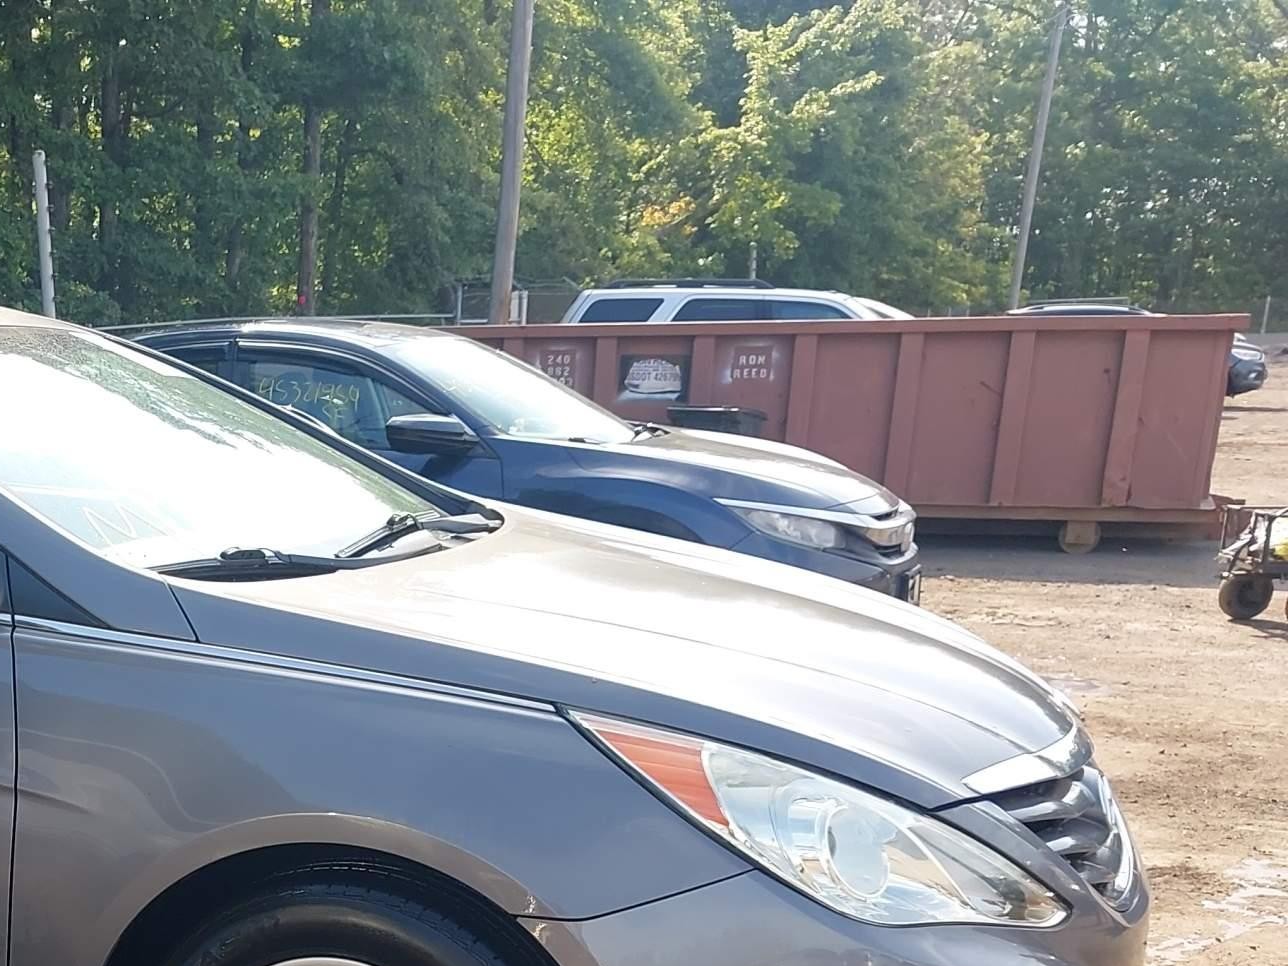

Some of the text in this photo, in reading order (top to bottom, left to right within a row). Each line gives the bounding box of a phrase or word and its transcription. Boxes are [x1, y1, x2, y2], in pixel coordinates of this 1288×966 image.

[547, 355, 570, 364] 240
[739, 355, 766, 365] RON
[733, 368, 767, 378] REED
